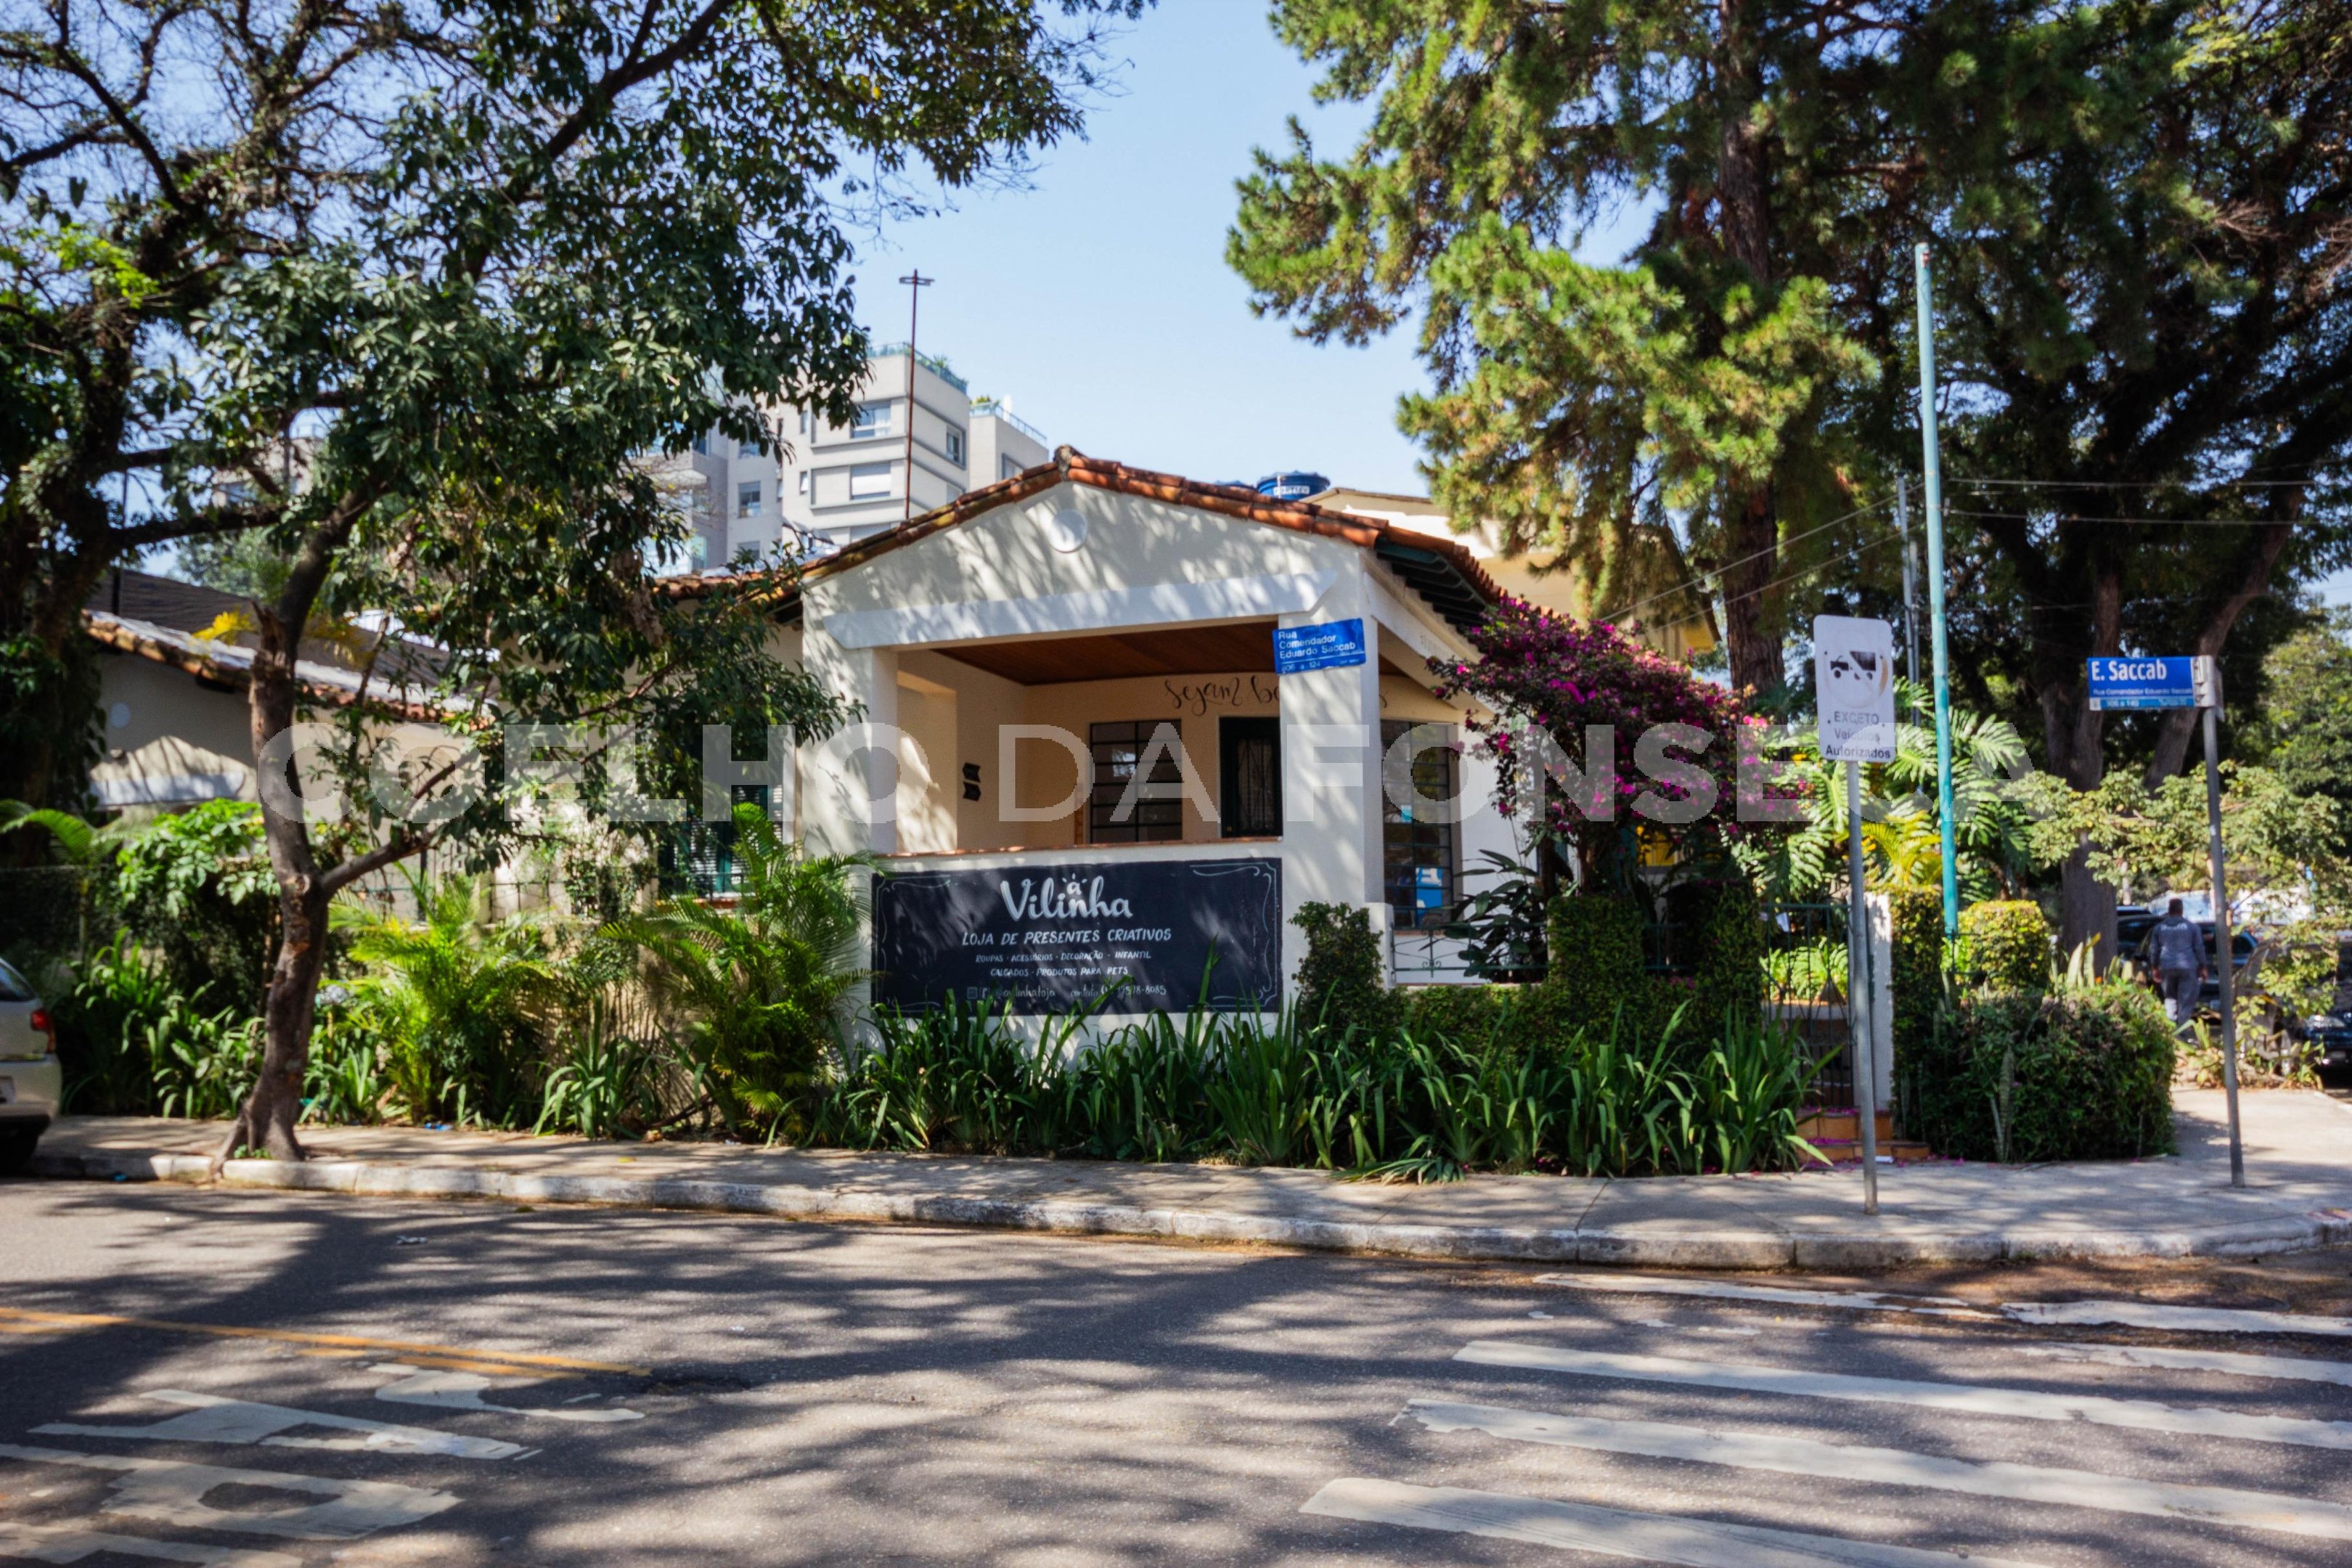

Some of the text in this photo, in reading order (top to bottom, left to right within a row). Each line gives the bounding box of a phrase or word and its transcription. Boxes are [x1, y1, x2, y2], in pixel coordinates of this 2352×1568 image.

[1278, 631, 1297, 640] Rua
[1279, 635, 1336, 649] Comendador
[1280, 648, 1318, 659] Eduardo
[1321, 642, 1356, 653] Saccab
[2091, 658, 2167, 681] E. Saccab
[1834, 711, 1879, 724] EXCETO
[1826, 745, 1891, 759] Autorizados
[1000, 875, 1133, 921] Vilinha
[962, 928, 1172, 945] LOJA DE PRESENTES CRIATIVOS
[976, 955, 1003, 963] ROUPAS
[1010, 953, 1053, 963] ACESSÓRIOS
[1061, 950, 1103, 962] DECORAÇÃO
[1036, 967, 1077, 976] PRODUTOS
[1080, 967, 1101, 976] PARA
[1107, 966, 1128, 975] PETS
